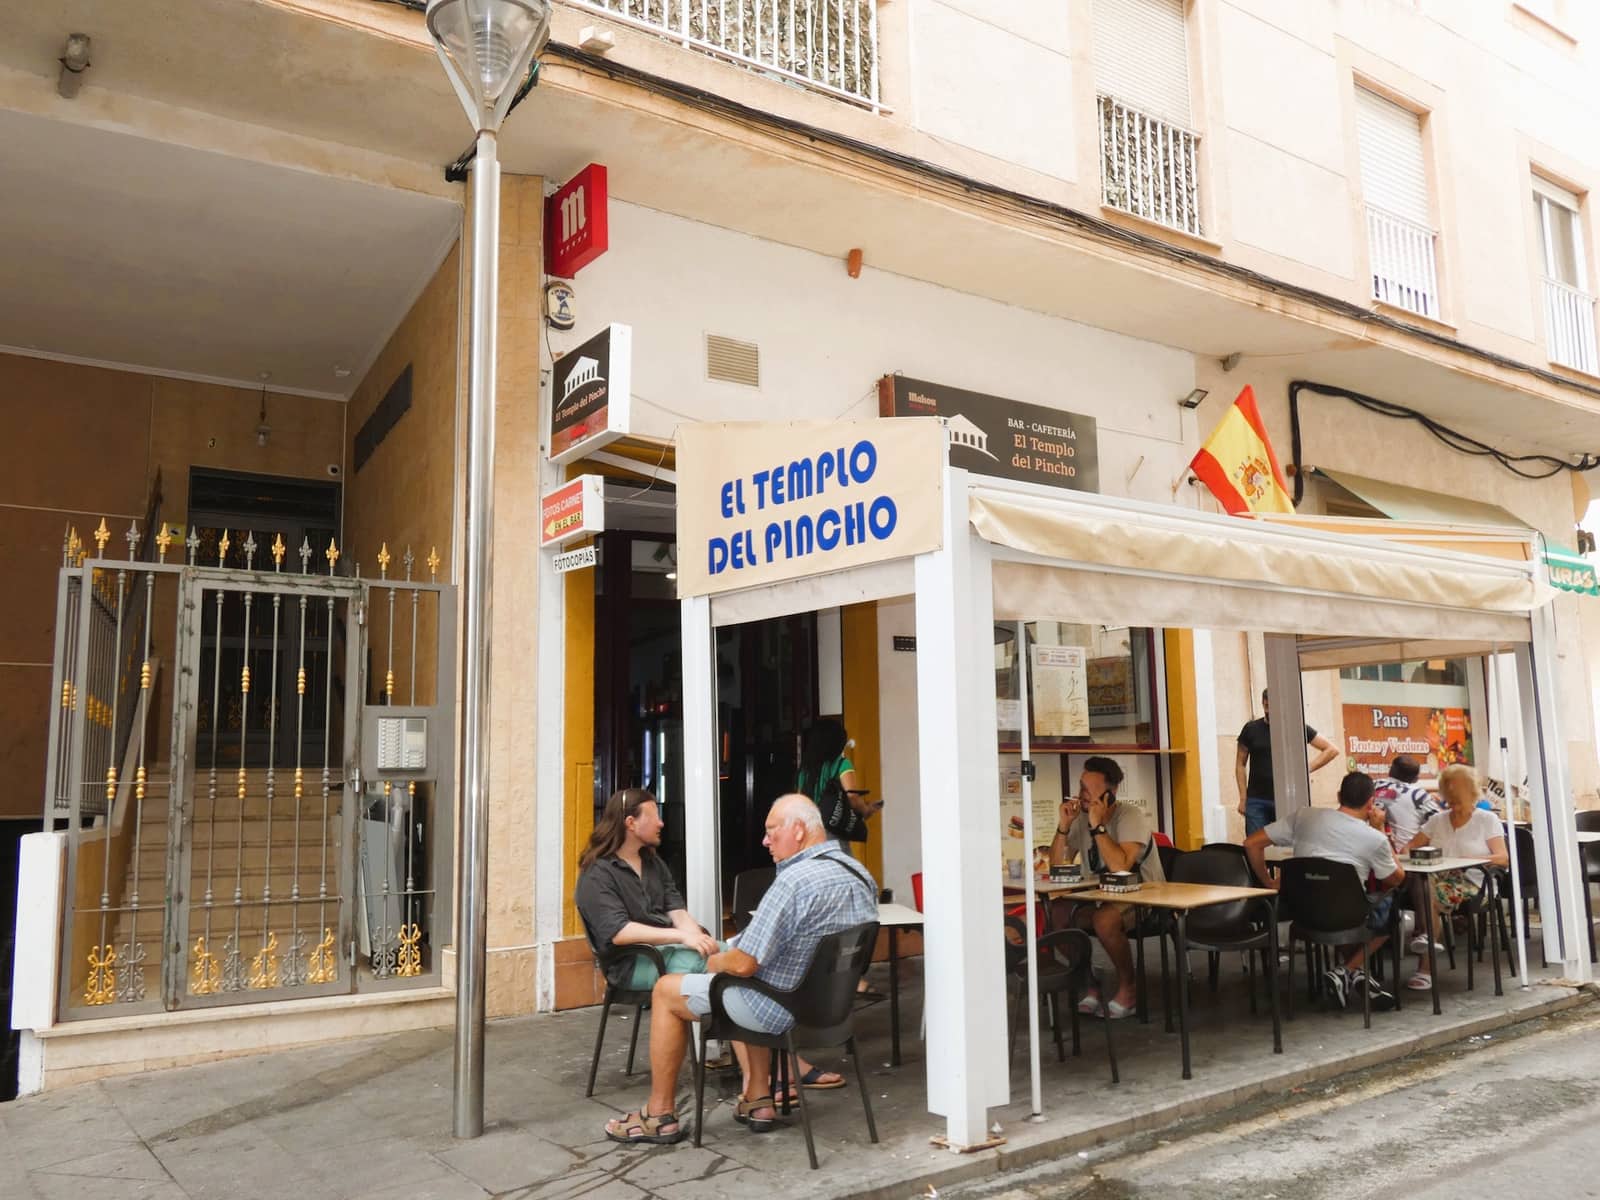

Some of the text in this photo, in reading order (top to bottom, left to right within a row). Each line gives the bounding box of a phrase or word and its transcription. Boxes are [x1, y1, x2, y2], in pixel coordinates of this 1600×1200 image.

[1008, 418, 1024, 430] BAR
[1031, 422, 1076, 440] CAFETERÍA
[1014, 433, 1075, 458] El Templo
[1012, 453, 1076, 477] del Pincho
[721, 440, 877, 519] EL TEMPLO
[570, 512, 581, 526] BAR
[708, 495, 898, 575] DEL PINCHO
[554, 550, 594, 570] FOTOCOPIAS
[1550, 566, 1593, 588] URAS
[1372, 708, 1408, 728] Paris
[1388, 736, 1430, 754] Verduras
